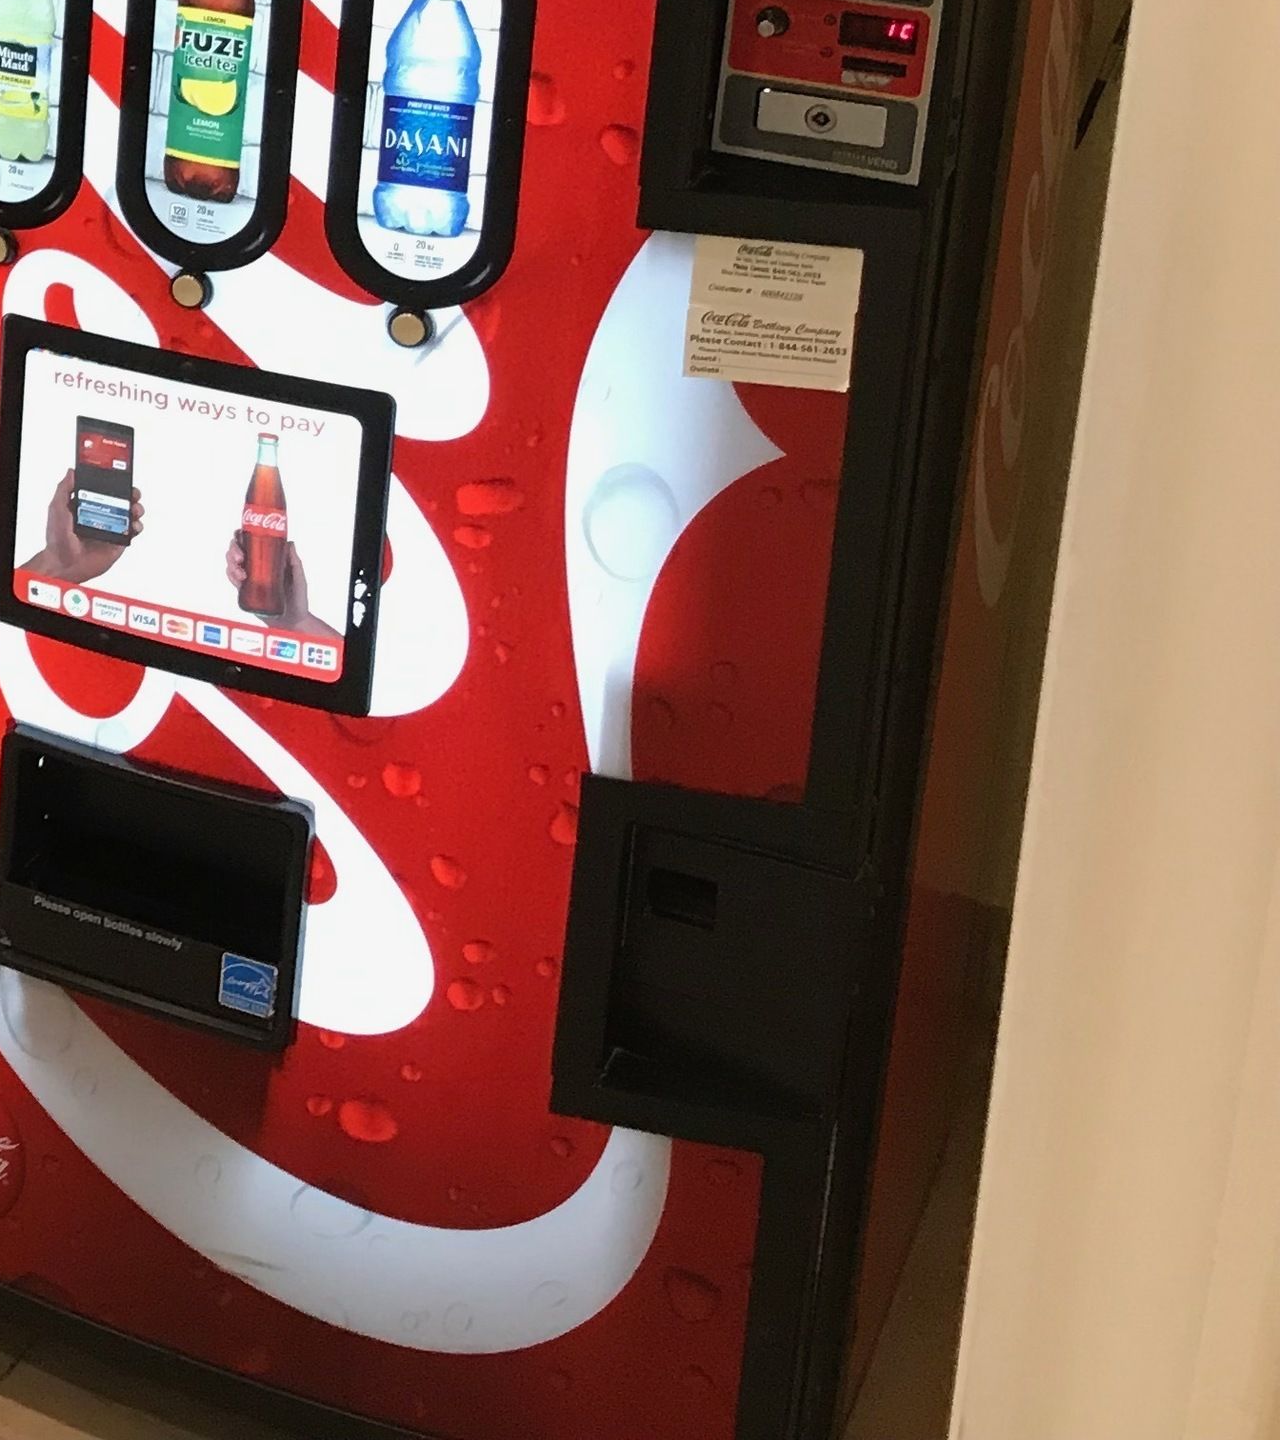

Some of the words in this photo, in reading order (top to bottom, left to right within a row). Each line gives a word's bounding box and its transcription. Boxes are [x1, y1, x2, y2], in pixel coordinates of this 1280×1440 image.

[181, 30, 244, 58] FUZE
[0, 57, 29, 72] Maid
[185, 52, 212, 68] iced
[216, 58, 237, 73] tea
[192, 118, 220, 129] LEMON
[385, 127, 467, 158] DASANI
[197, 205, 207, 215] 20
[416, 240, 426, 249] 20
[795, 323, 842, 338] Company
[690, 334, 721, 344] Please
[723, 338, 761, 348] Contact
[54, 369, 169, 410] refreshing
[177, 396, 237, 421] ways
[246, 406, 271, 426] to
[280, 413, 326, 437] pay
[243, 509, 287, 531] Coca-Cola
[132, 613, 157, 626] VISA
[33, 894, 71, 915] Please
[73, 909, 102, 925] open
[103, 916, 143, 938] bottles
[144, 930, 183, 951] slowly
